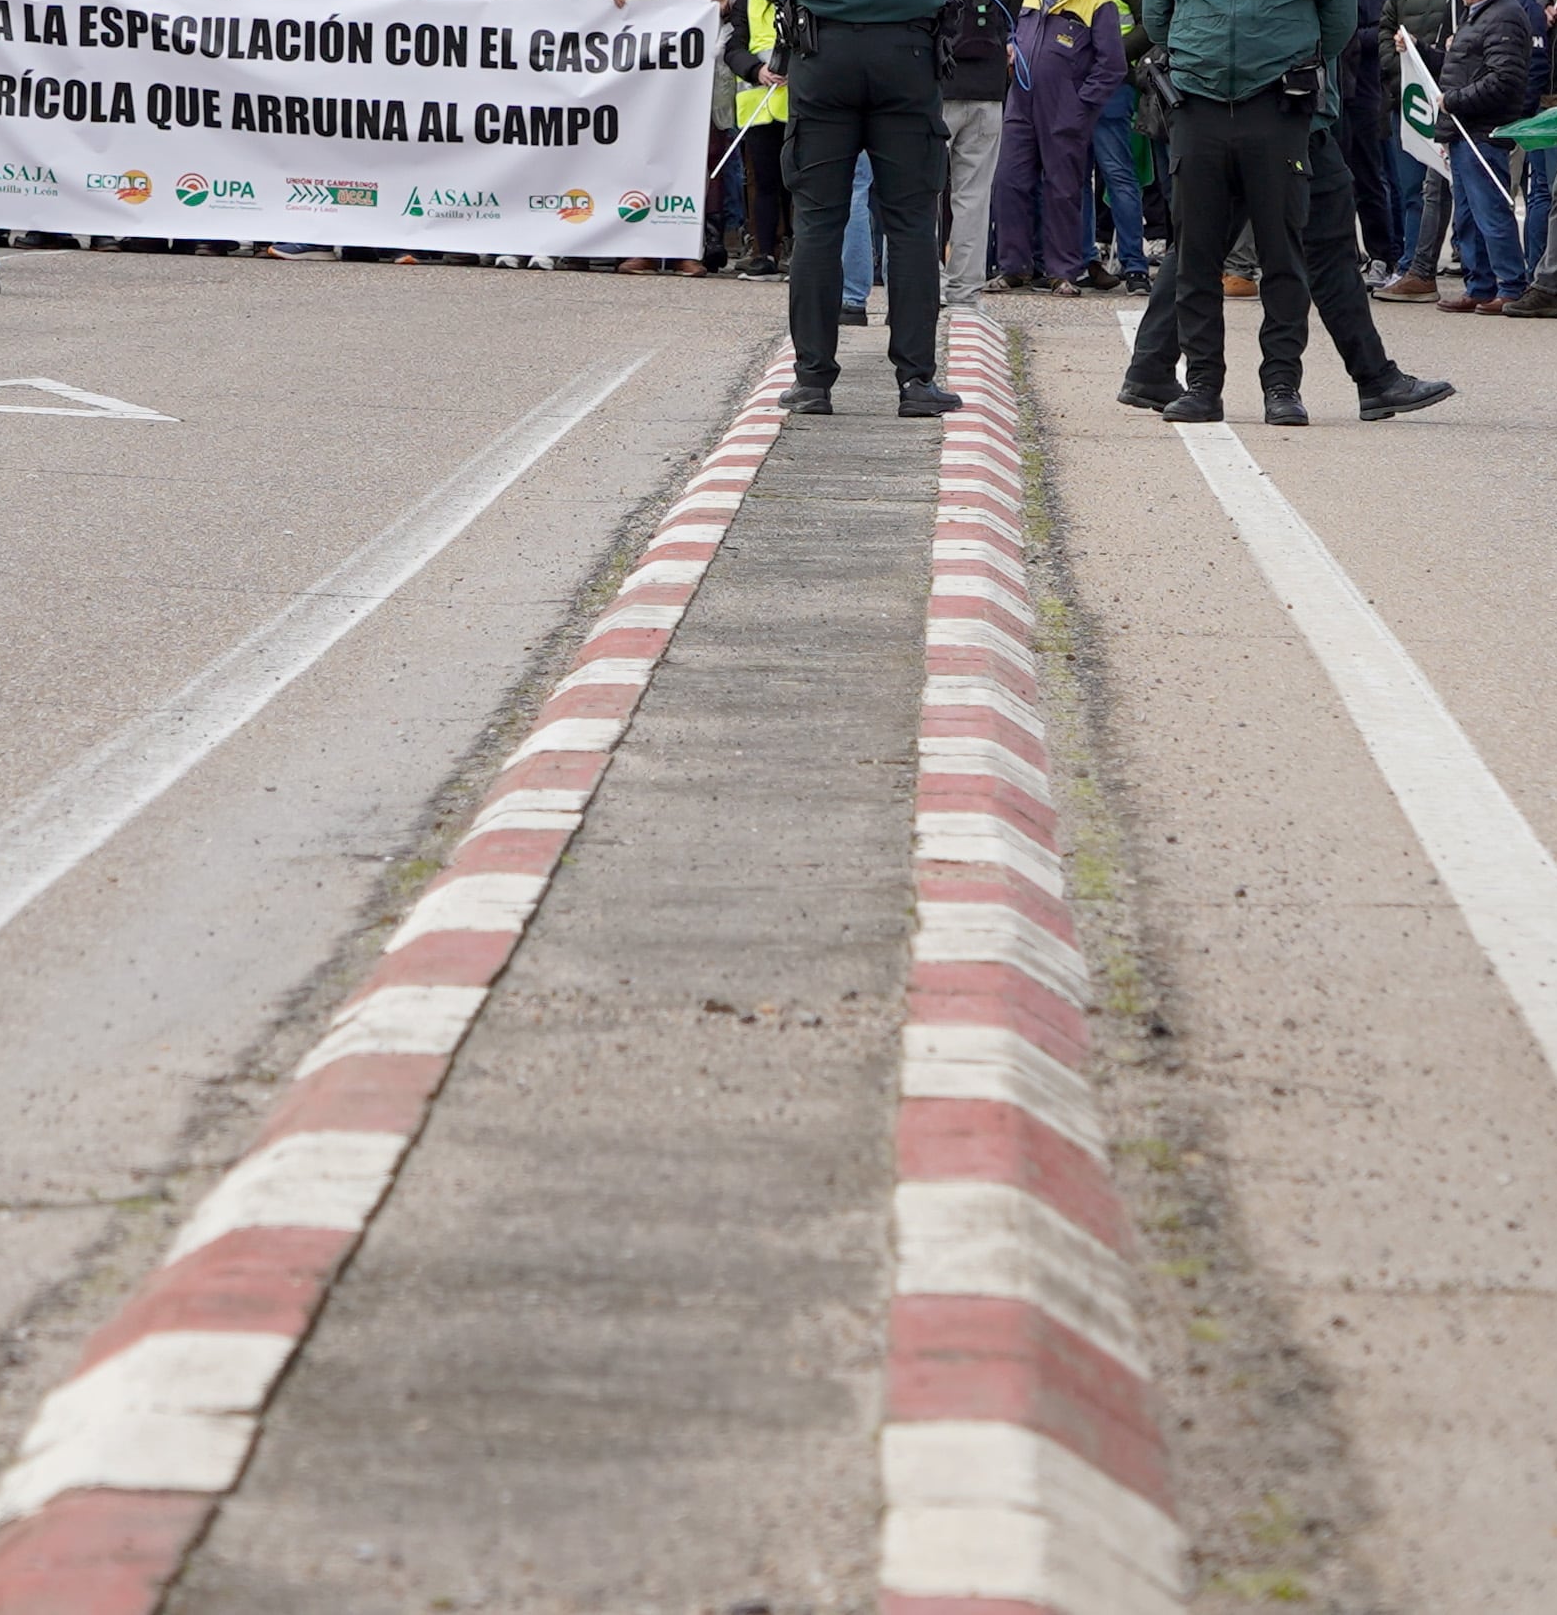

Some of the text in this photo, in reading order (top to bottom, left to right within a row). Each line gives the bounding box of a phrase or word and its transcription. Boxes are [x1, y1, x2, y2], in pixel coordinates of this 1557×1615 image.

[24, 3, 68, 46] LA
[80, 5, 373, 64] ESPECULACIÓN
[385, 22, 468, 68] CON
[480, 26, 518, 70] EL
[529, 24, 705, 73] GASÓLEO
[147, 83, 222, 130] QUE
[232, 92, 409, 142] ARRUINA
[417, 101, 464, 143] AL
[474, 103, 619, 147] CAMPO
[87, 173, 149, 190] COAG
[213, 180, 256, 199] UPA
[34, 186, 59, 197] León
[428, 188, 500, 208] ASAJA
[529, 195, 590, 210] COAG
[655, 195, 696, 213] UPA
[427, 209, 464, 219] Castilla
[476, 210, 501, 220] León
